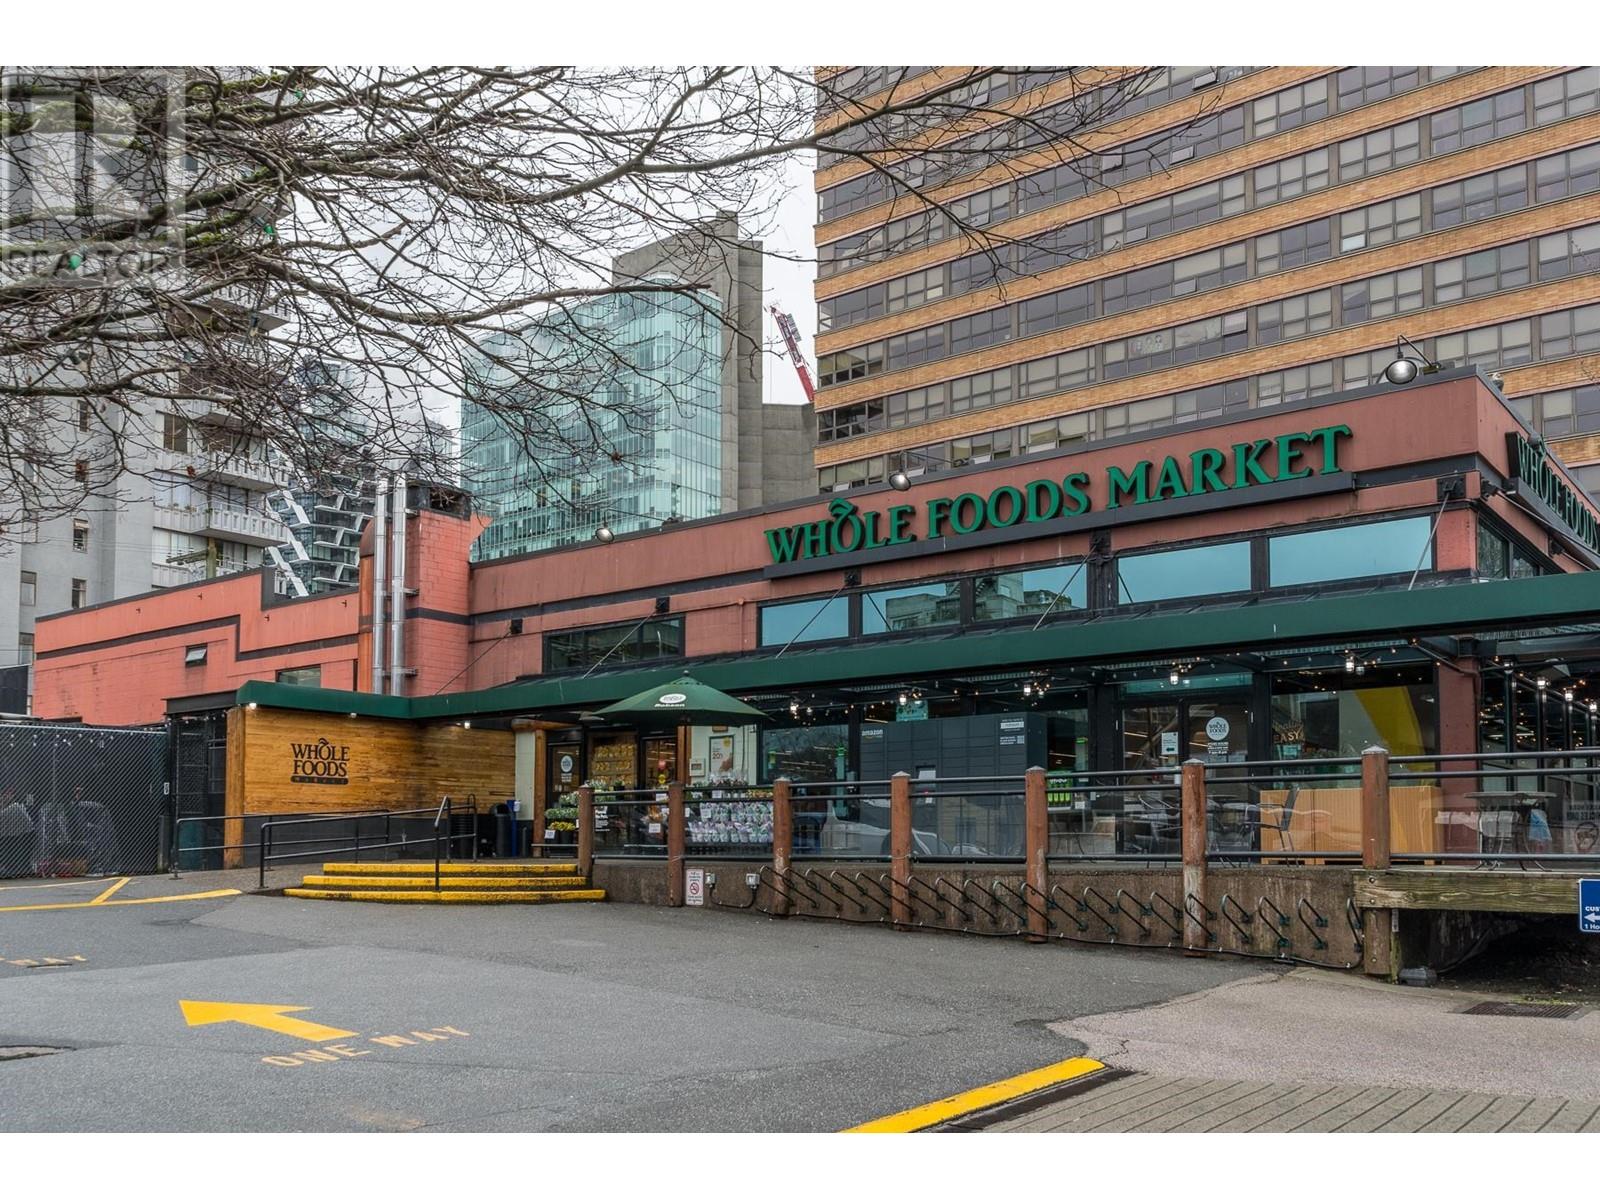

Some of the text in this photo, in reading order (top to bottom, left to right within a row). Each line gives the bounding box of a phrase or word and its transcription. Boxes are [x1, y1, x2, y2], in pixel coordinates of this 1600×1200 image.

[764, 424, 1353, 564] WHOLE FOODS MARKET
[1516, 433, 1563, 518] WHOLE
[290, 737, 351, 761] WHOLE
[293, 760, 348, 777] FOODS
[261, 1026, 470, 1067] ONE WAY
